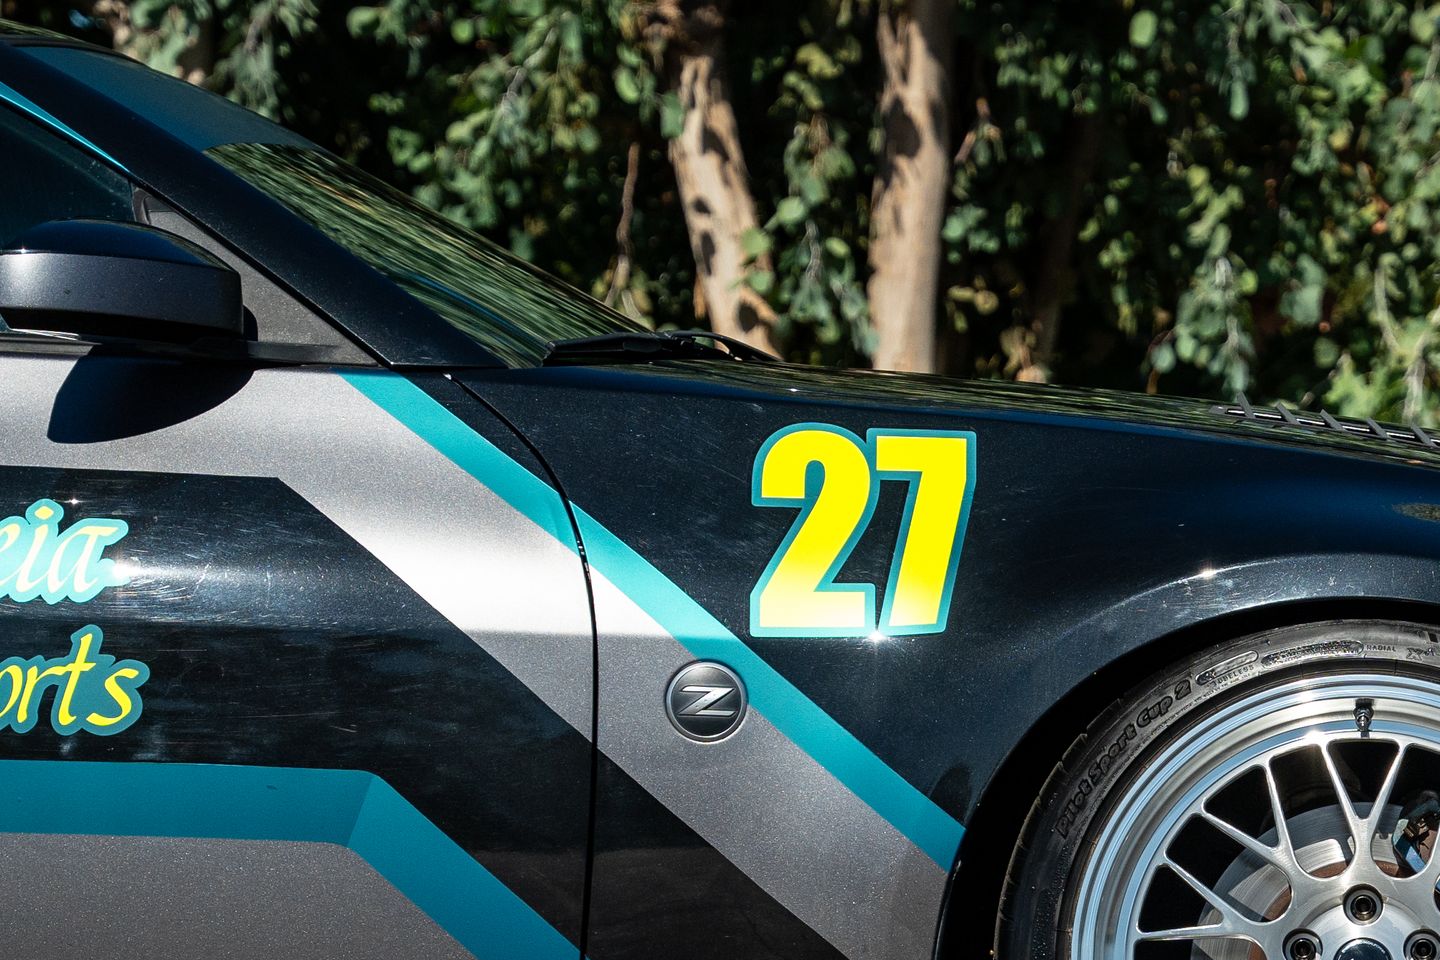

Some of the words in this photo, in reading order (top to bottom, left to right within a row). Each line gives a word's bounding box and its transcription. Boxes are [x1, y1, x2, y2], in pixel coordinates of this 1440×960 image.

[754, 425, 972, 633] 27
[1055, 779, 1092, 839] Pilot
[1088, 723, 1138, 786] Sport
[1137, 695, 1173, 728] Cup
[1174, 679, 1192, 700] 2
